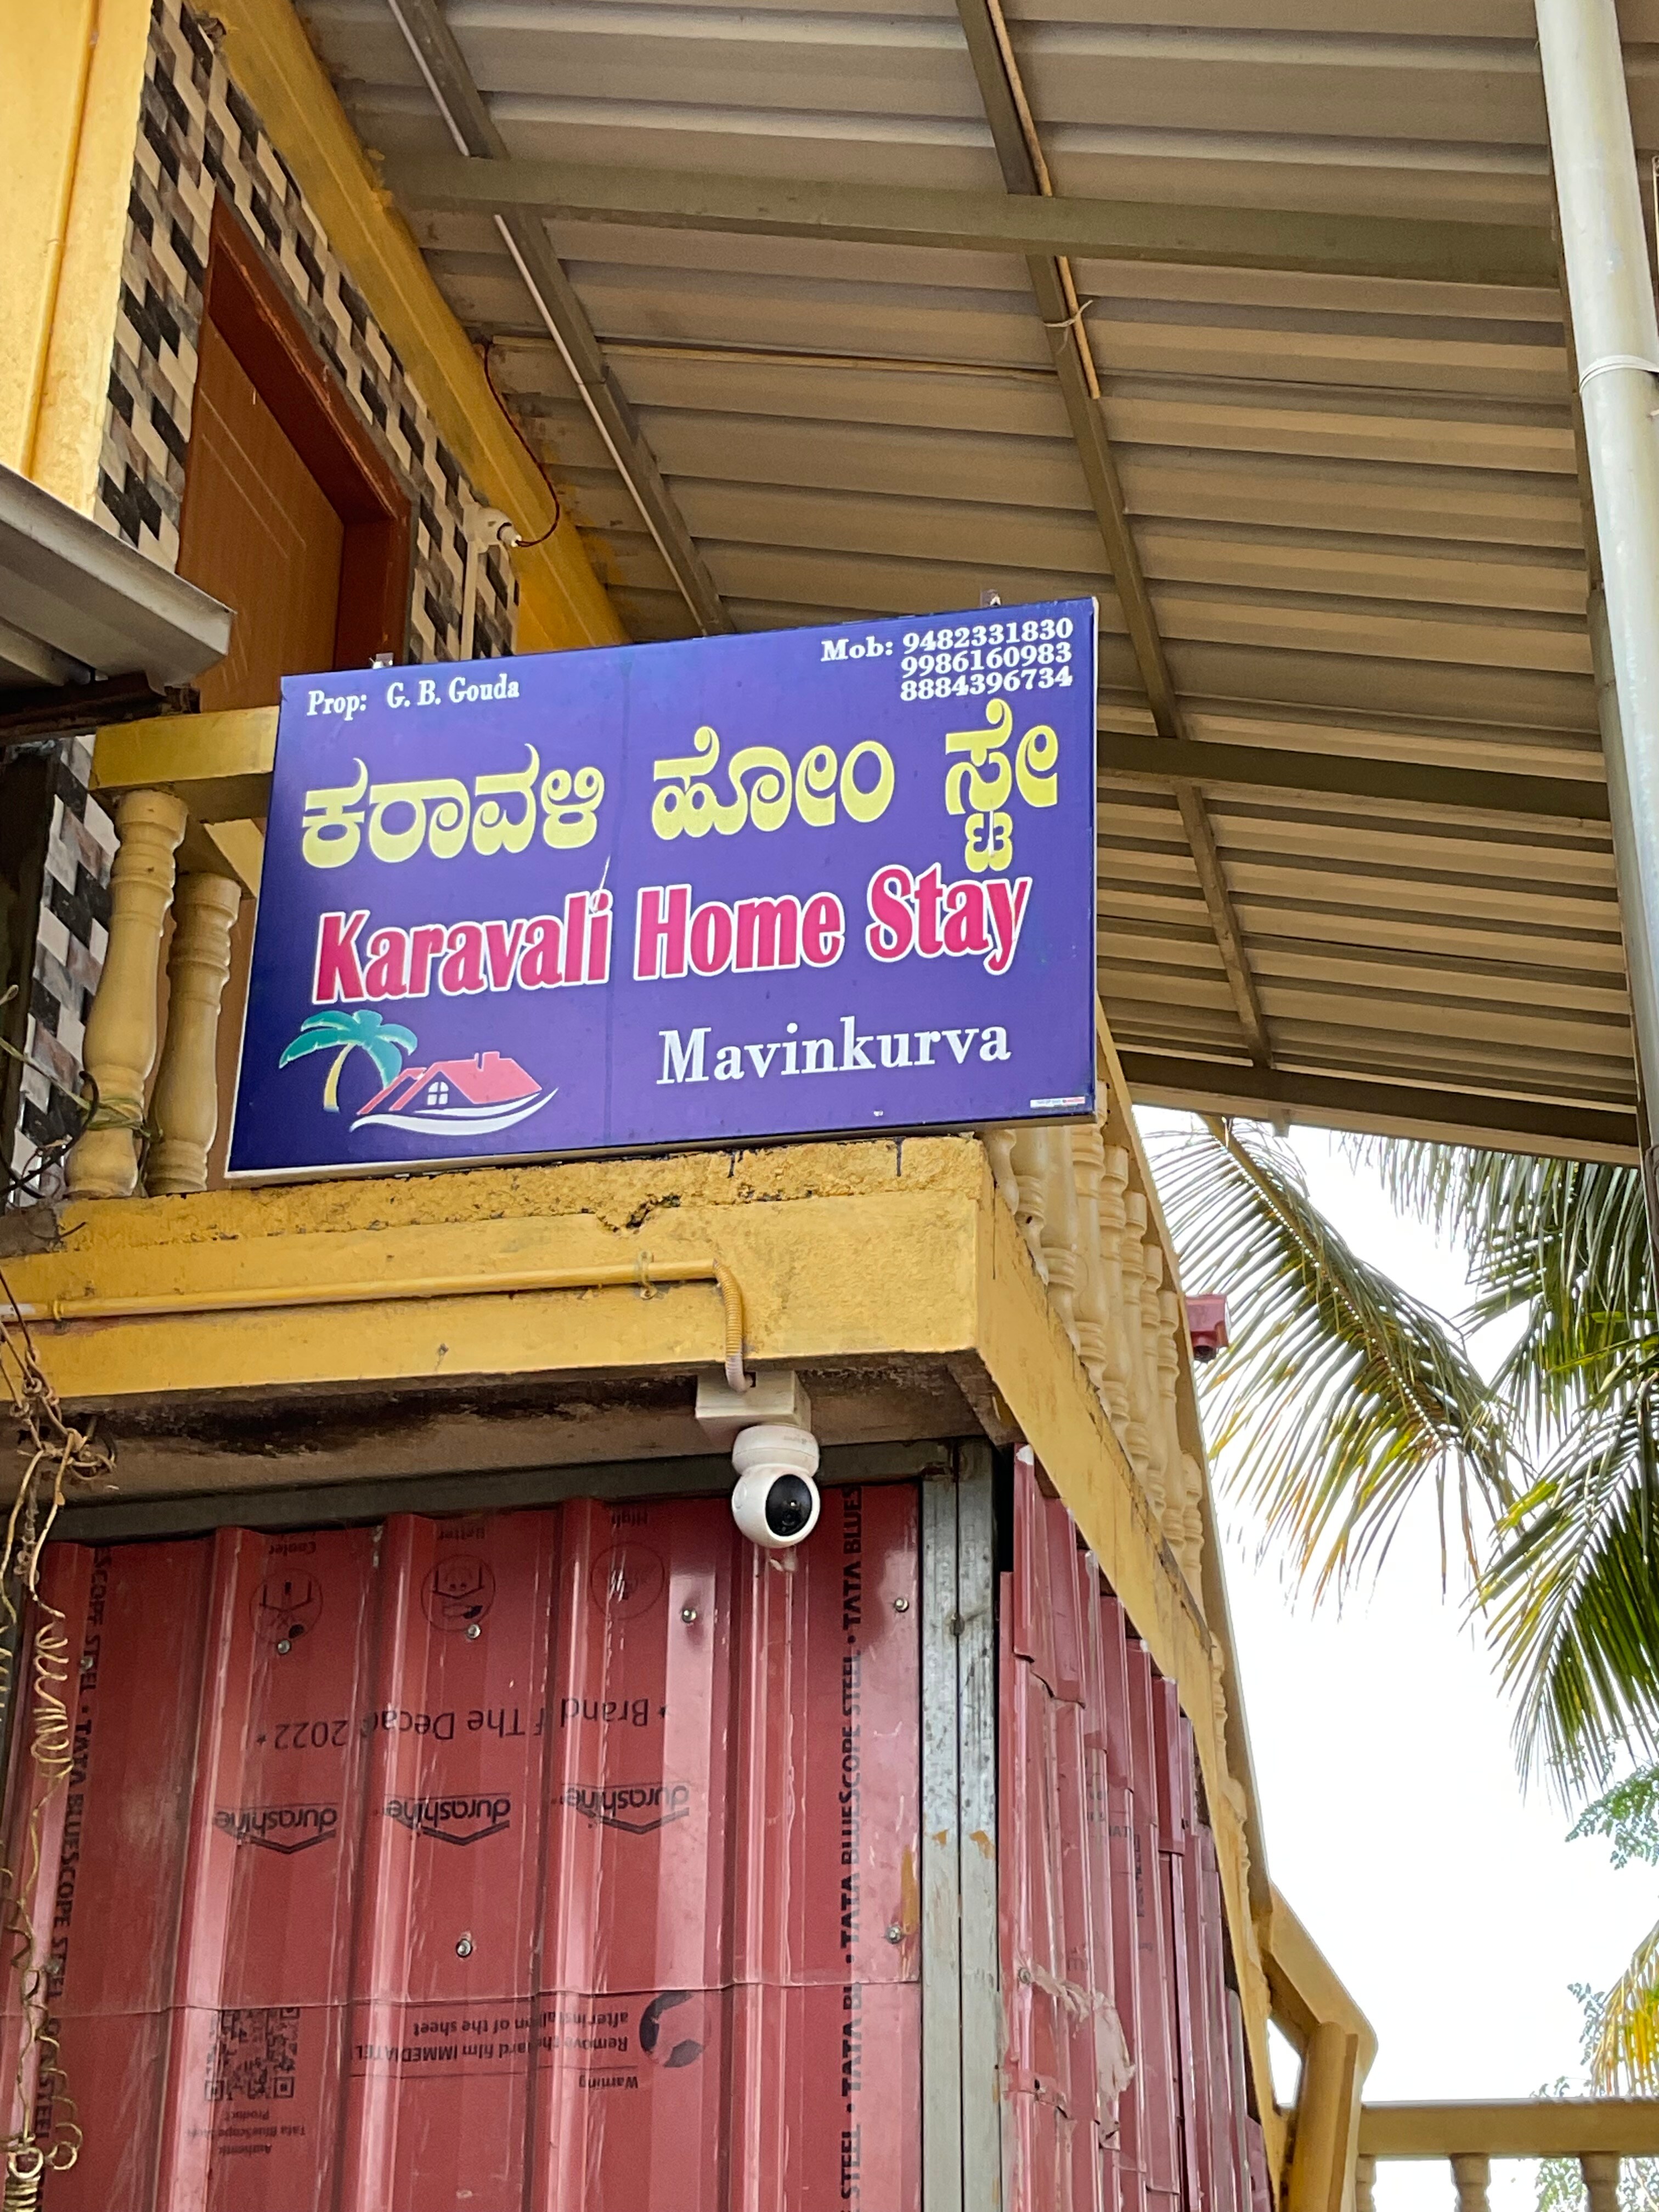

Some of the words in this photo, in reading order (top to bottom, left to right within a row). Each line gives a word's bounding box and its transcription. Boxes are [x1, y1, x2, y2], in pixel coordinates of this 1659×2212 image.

[821, 636, 893, 662] Mob:
[902, 618, 1073, 654] 9482331830
[901, 642, 1072, 678] 9986160983
[307, 690, 367, 720] Prop:
[387, 682, 410, 708] G.
[417, 680, 441, 706] B.
[449, 673, 520, 702] Gouda
[900, 666, 1073, 701] 8884396734
[302, 743, 605, 867] ಕರಾವಳಿ
[652, 726, 895, 840] ಹೋಂ
[946, 698, 1059, 872] ಸ್ಟೇ
[312, 889, 613, 1005] Karavali
[633, 883, 845, 981] Home
[865, 862, 1032, 975] Stay
[656, 1015, 1011, 1085] Mavinkurva
[842, 1561, 862, 1630] TATA
[840, 1649, 861, 1717] STEEL
[466, 1708, 526, 1739] The
[561, 1698, 649, 1728] Brand
[69, 1718, 93, 1788] TATA
[274, 1719, 348, 1750] 2022
[840, 1872, 860, 1949] TATA
[413, 2021, 458, 2038] sheet
[462, 2019, 489, 2035] the
[492, 2019, 510, 2034] of
[349, 2044, 458, 2063] IMMEDIATEL
[462, 2042, 494, 2059] film
[841, 2018, 862, 2096] TATA
[578, 2075, 639, 2091] Warning
[840, 2124, 861, 2200] STEEL
